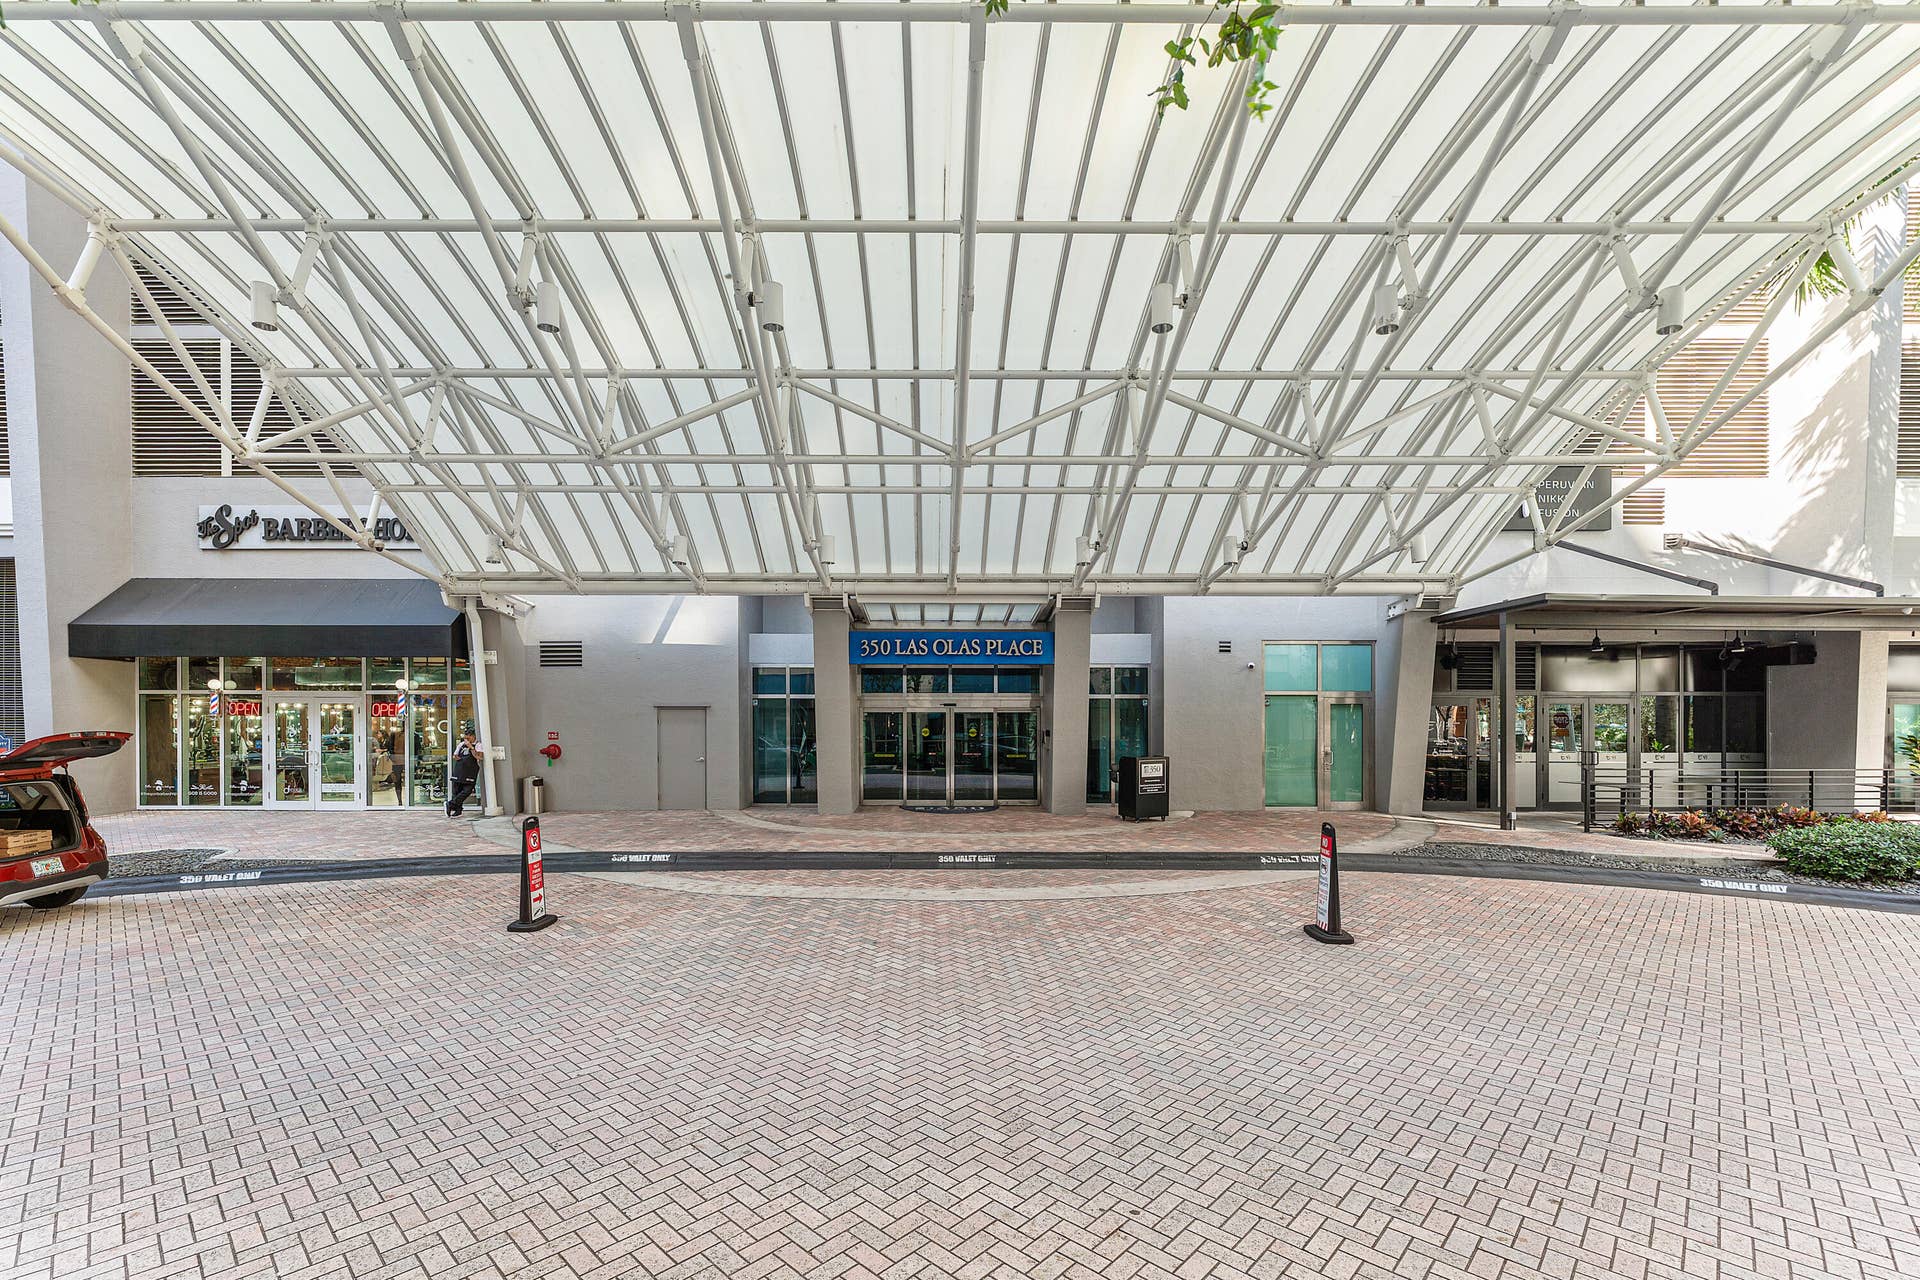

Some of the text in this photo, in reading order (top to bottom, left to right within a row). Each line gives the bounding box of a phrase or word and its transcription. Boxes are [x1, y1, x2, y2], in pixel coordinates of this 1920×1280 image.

[1538, 480, 1594, 489] PERUVN
[1539, 508, 1579, 517] FUSON
[197, 516, 220, 538] The
[212, 504, 259, 548] Spot
[860, 638, 1044, 657] 350 LAS OLAS PLACE
[228, 702, 260, 716] OPEN
[938, 855, 954, 863] 350
[955, 854, 977, 863] VALET
[180, 875, 203, 884] 350
[204, 873, 236, 882] VALET
[1700, 878, 1787, 893] 350 VALET ONLY
